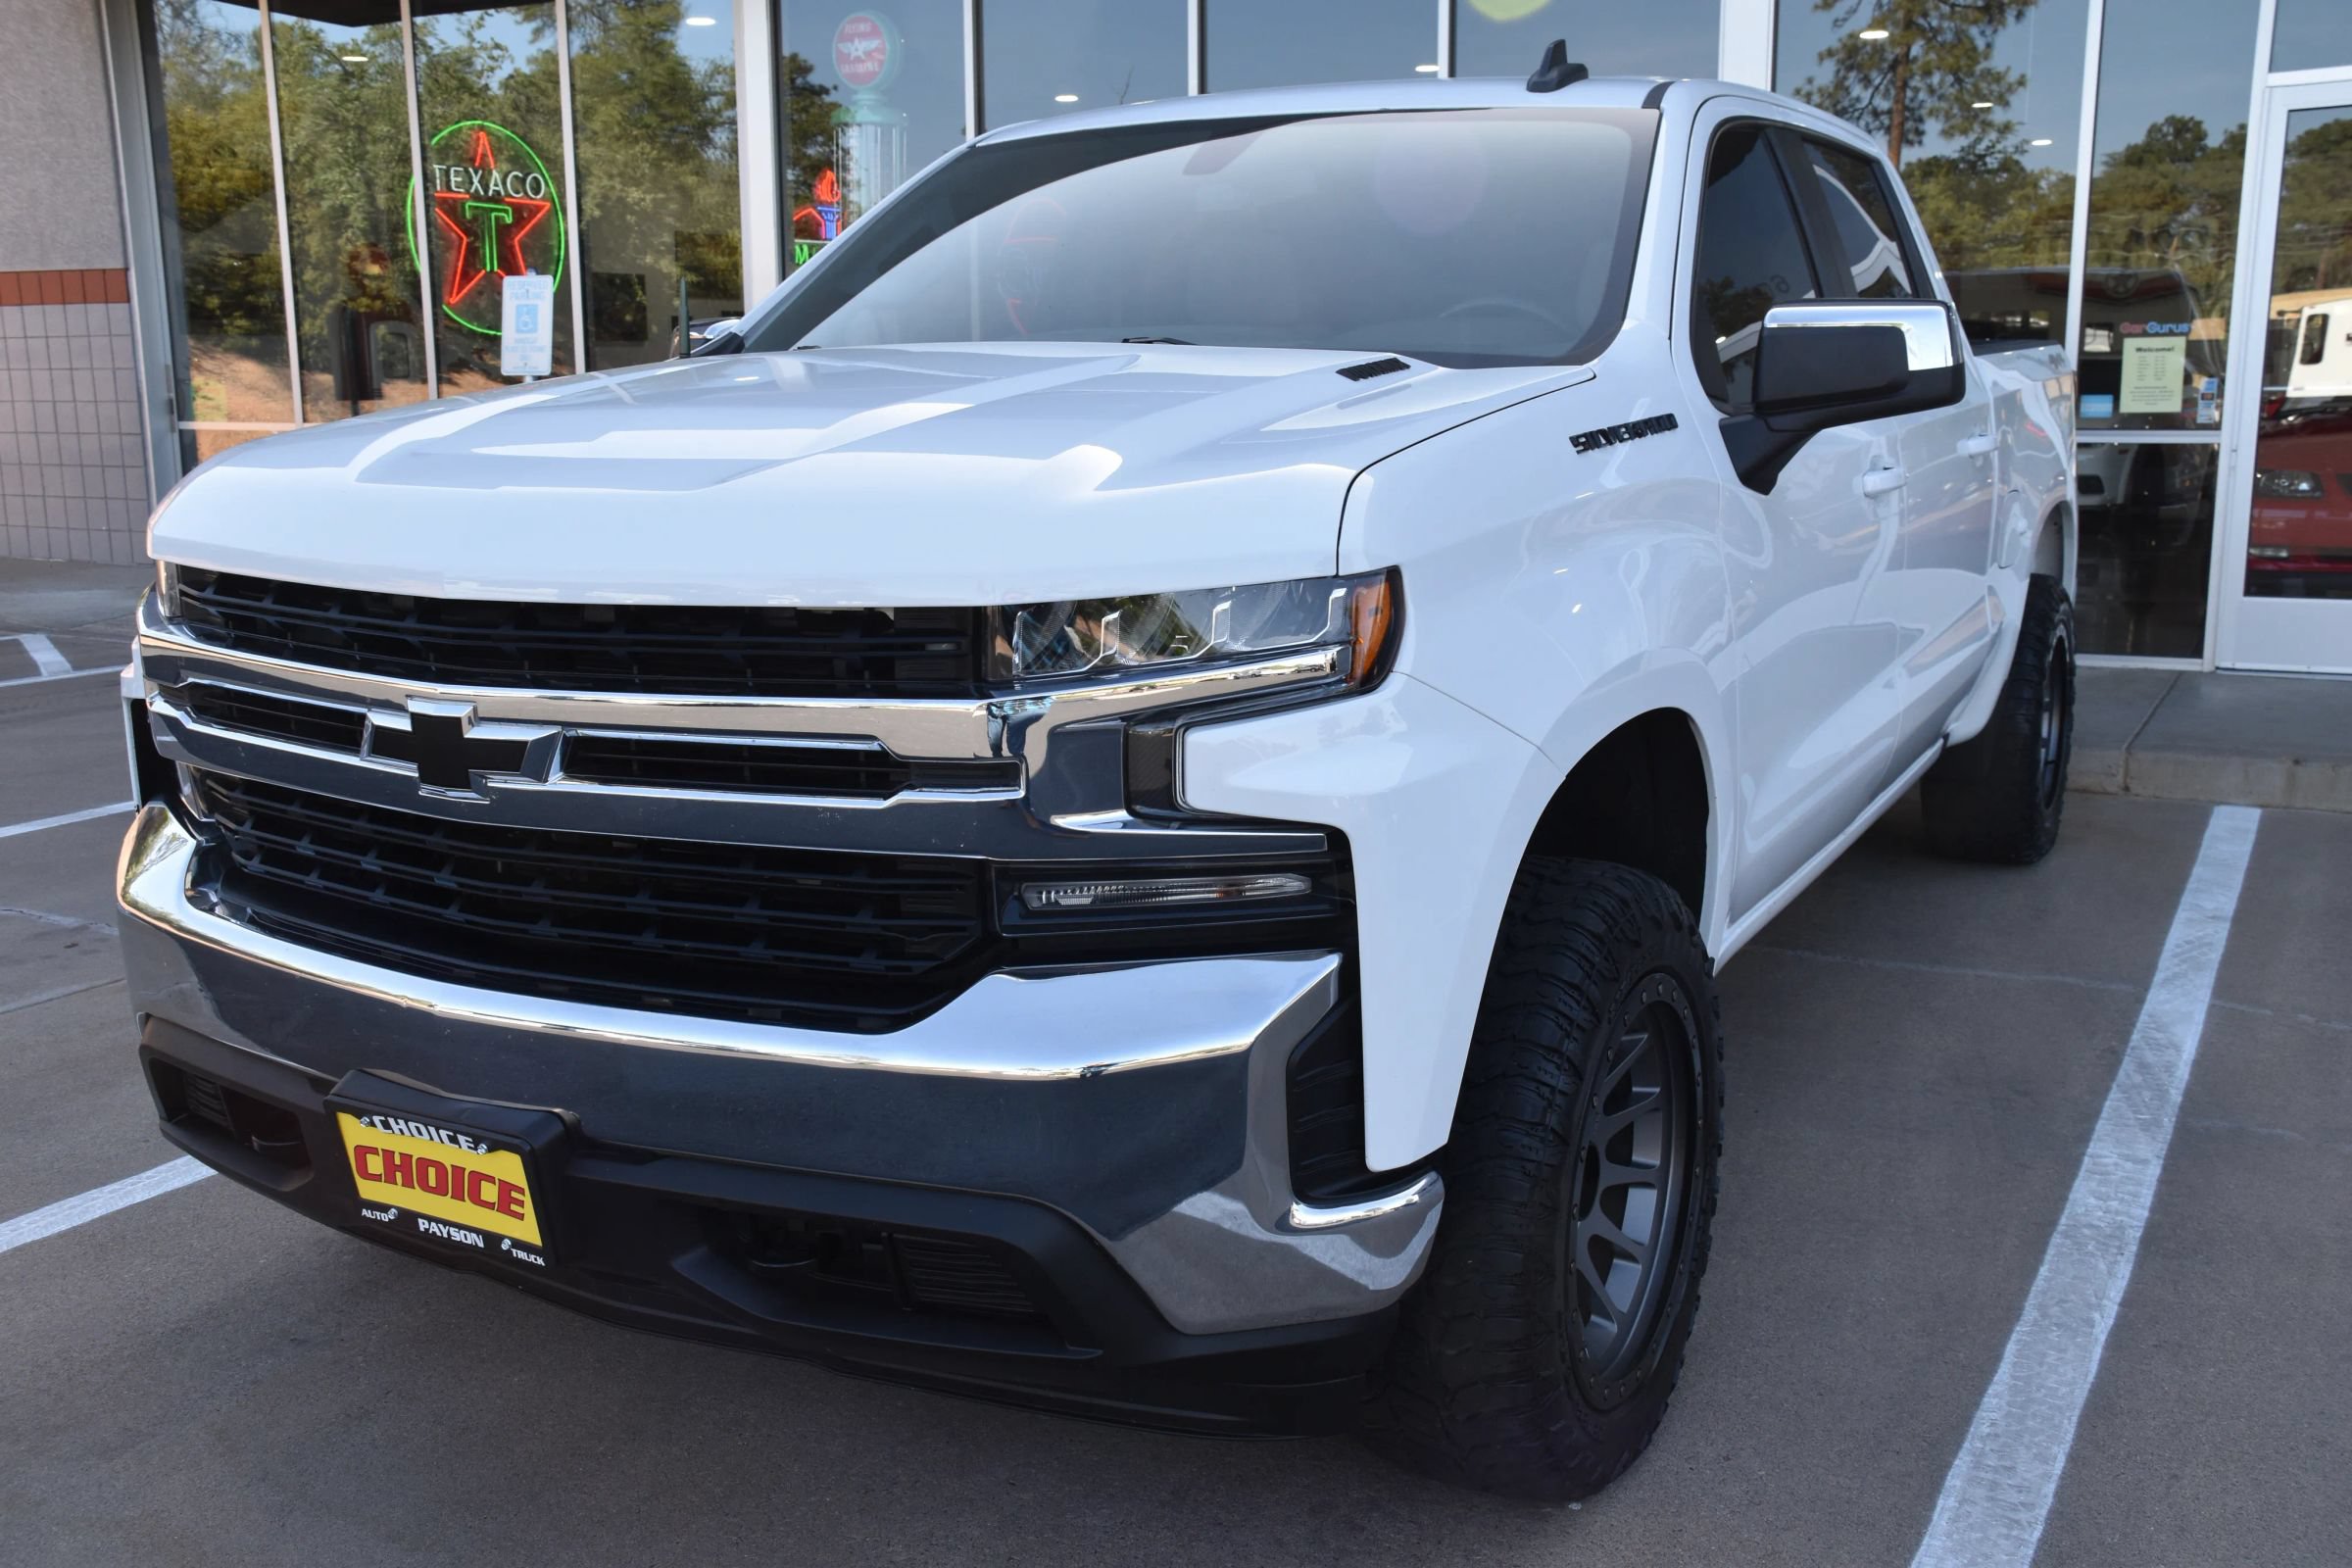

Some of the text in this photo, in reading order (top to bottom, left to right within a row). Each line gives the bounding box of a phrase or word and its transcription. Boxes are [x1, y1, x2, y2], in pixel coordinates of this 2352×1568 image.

[432, 164, 545, 199] TEXACO
[2120, 321, 2188, 334] CarGurus
[1569, 413, 1679, 455] SILVERADO
[371, 1115, 477, 1154] CHOICE
[354, 1145, 526, 1221] CHOICE
[362, 1208, 546, 1266] AUTO PAYSON TRUCK
